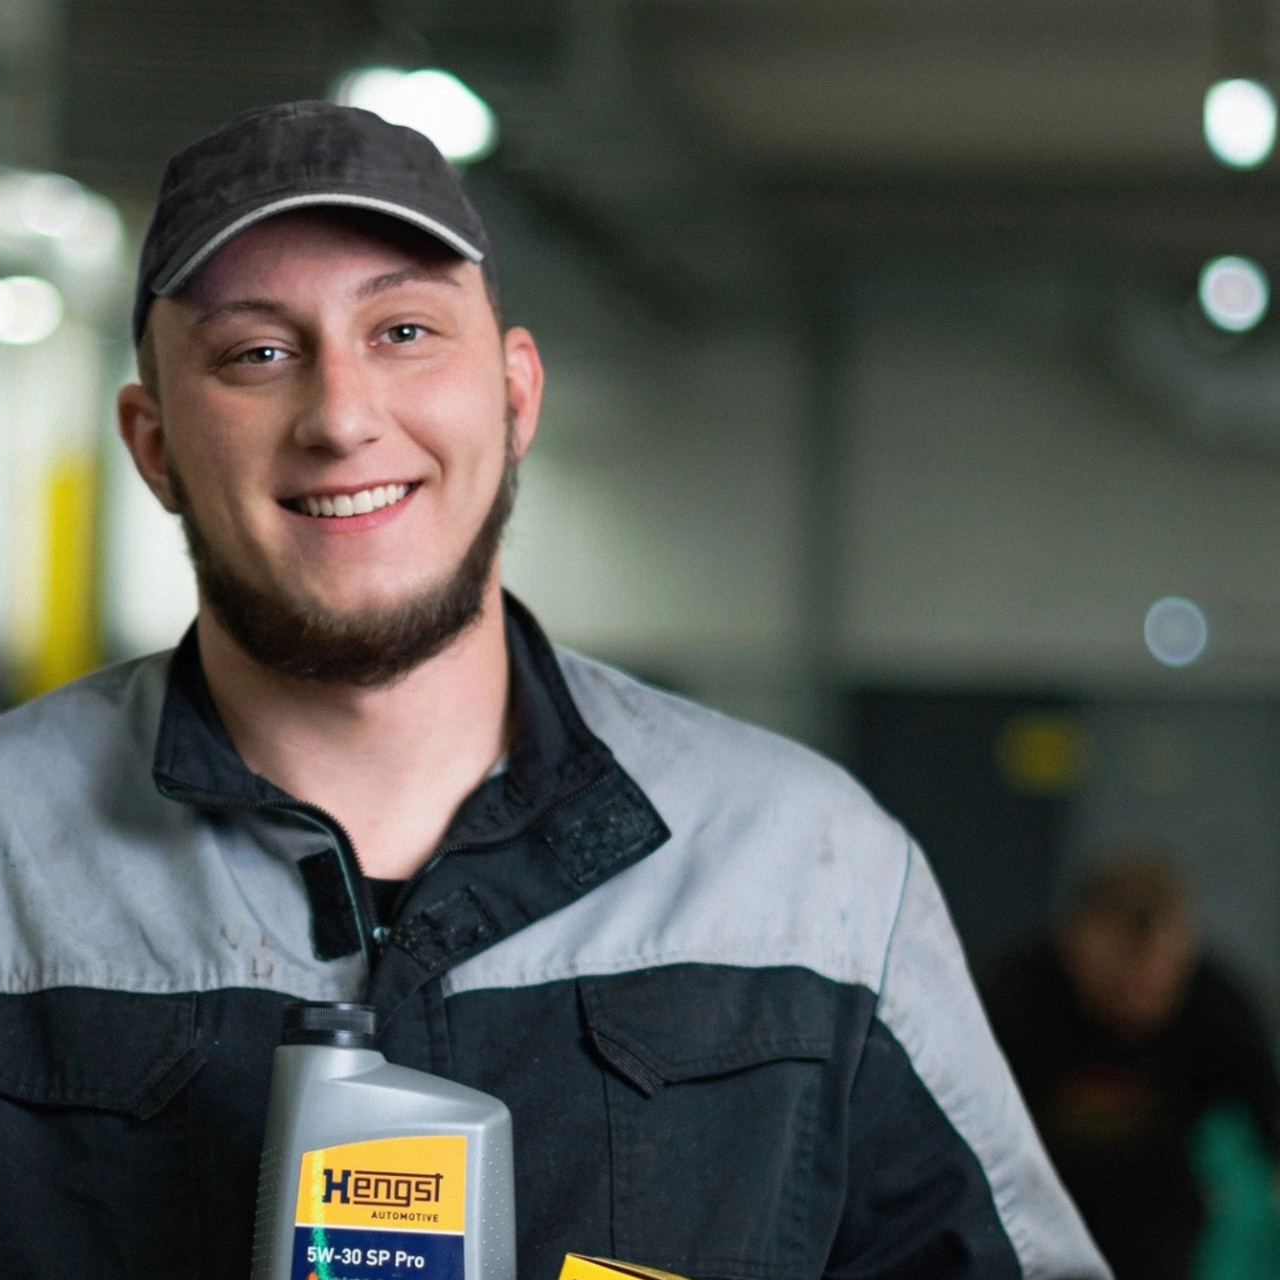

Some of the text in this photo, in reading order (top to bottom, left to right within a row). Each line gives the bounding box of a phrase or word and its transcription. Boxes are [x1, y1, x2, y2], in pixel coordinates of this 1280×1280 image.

[322, 1168, 444, 1207] Hengst
[371, 1211, 439, 1223] AUTOMOTIVE
[306, 1246, 425, 1268] 5W-30 SP Pro
